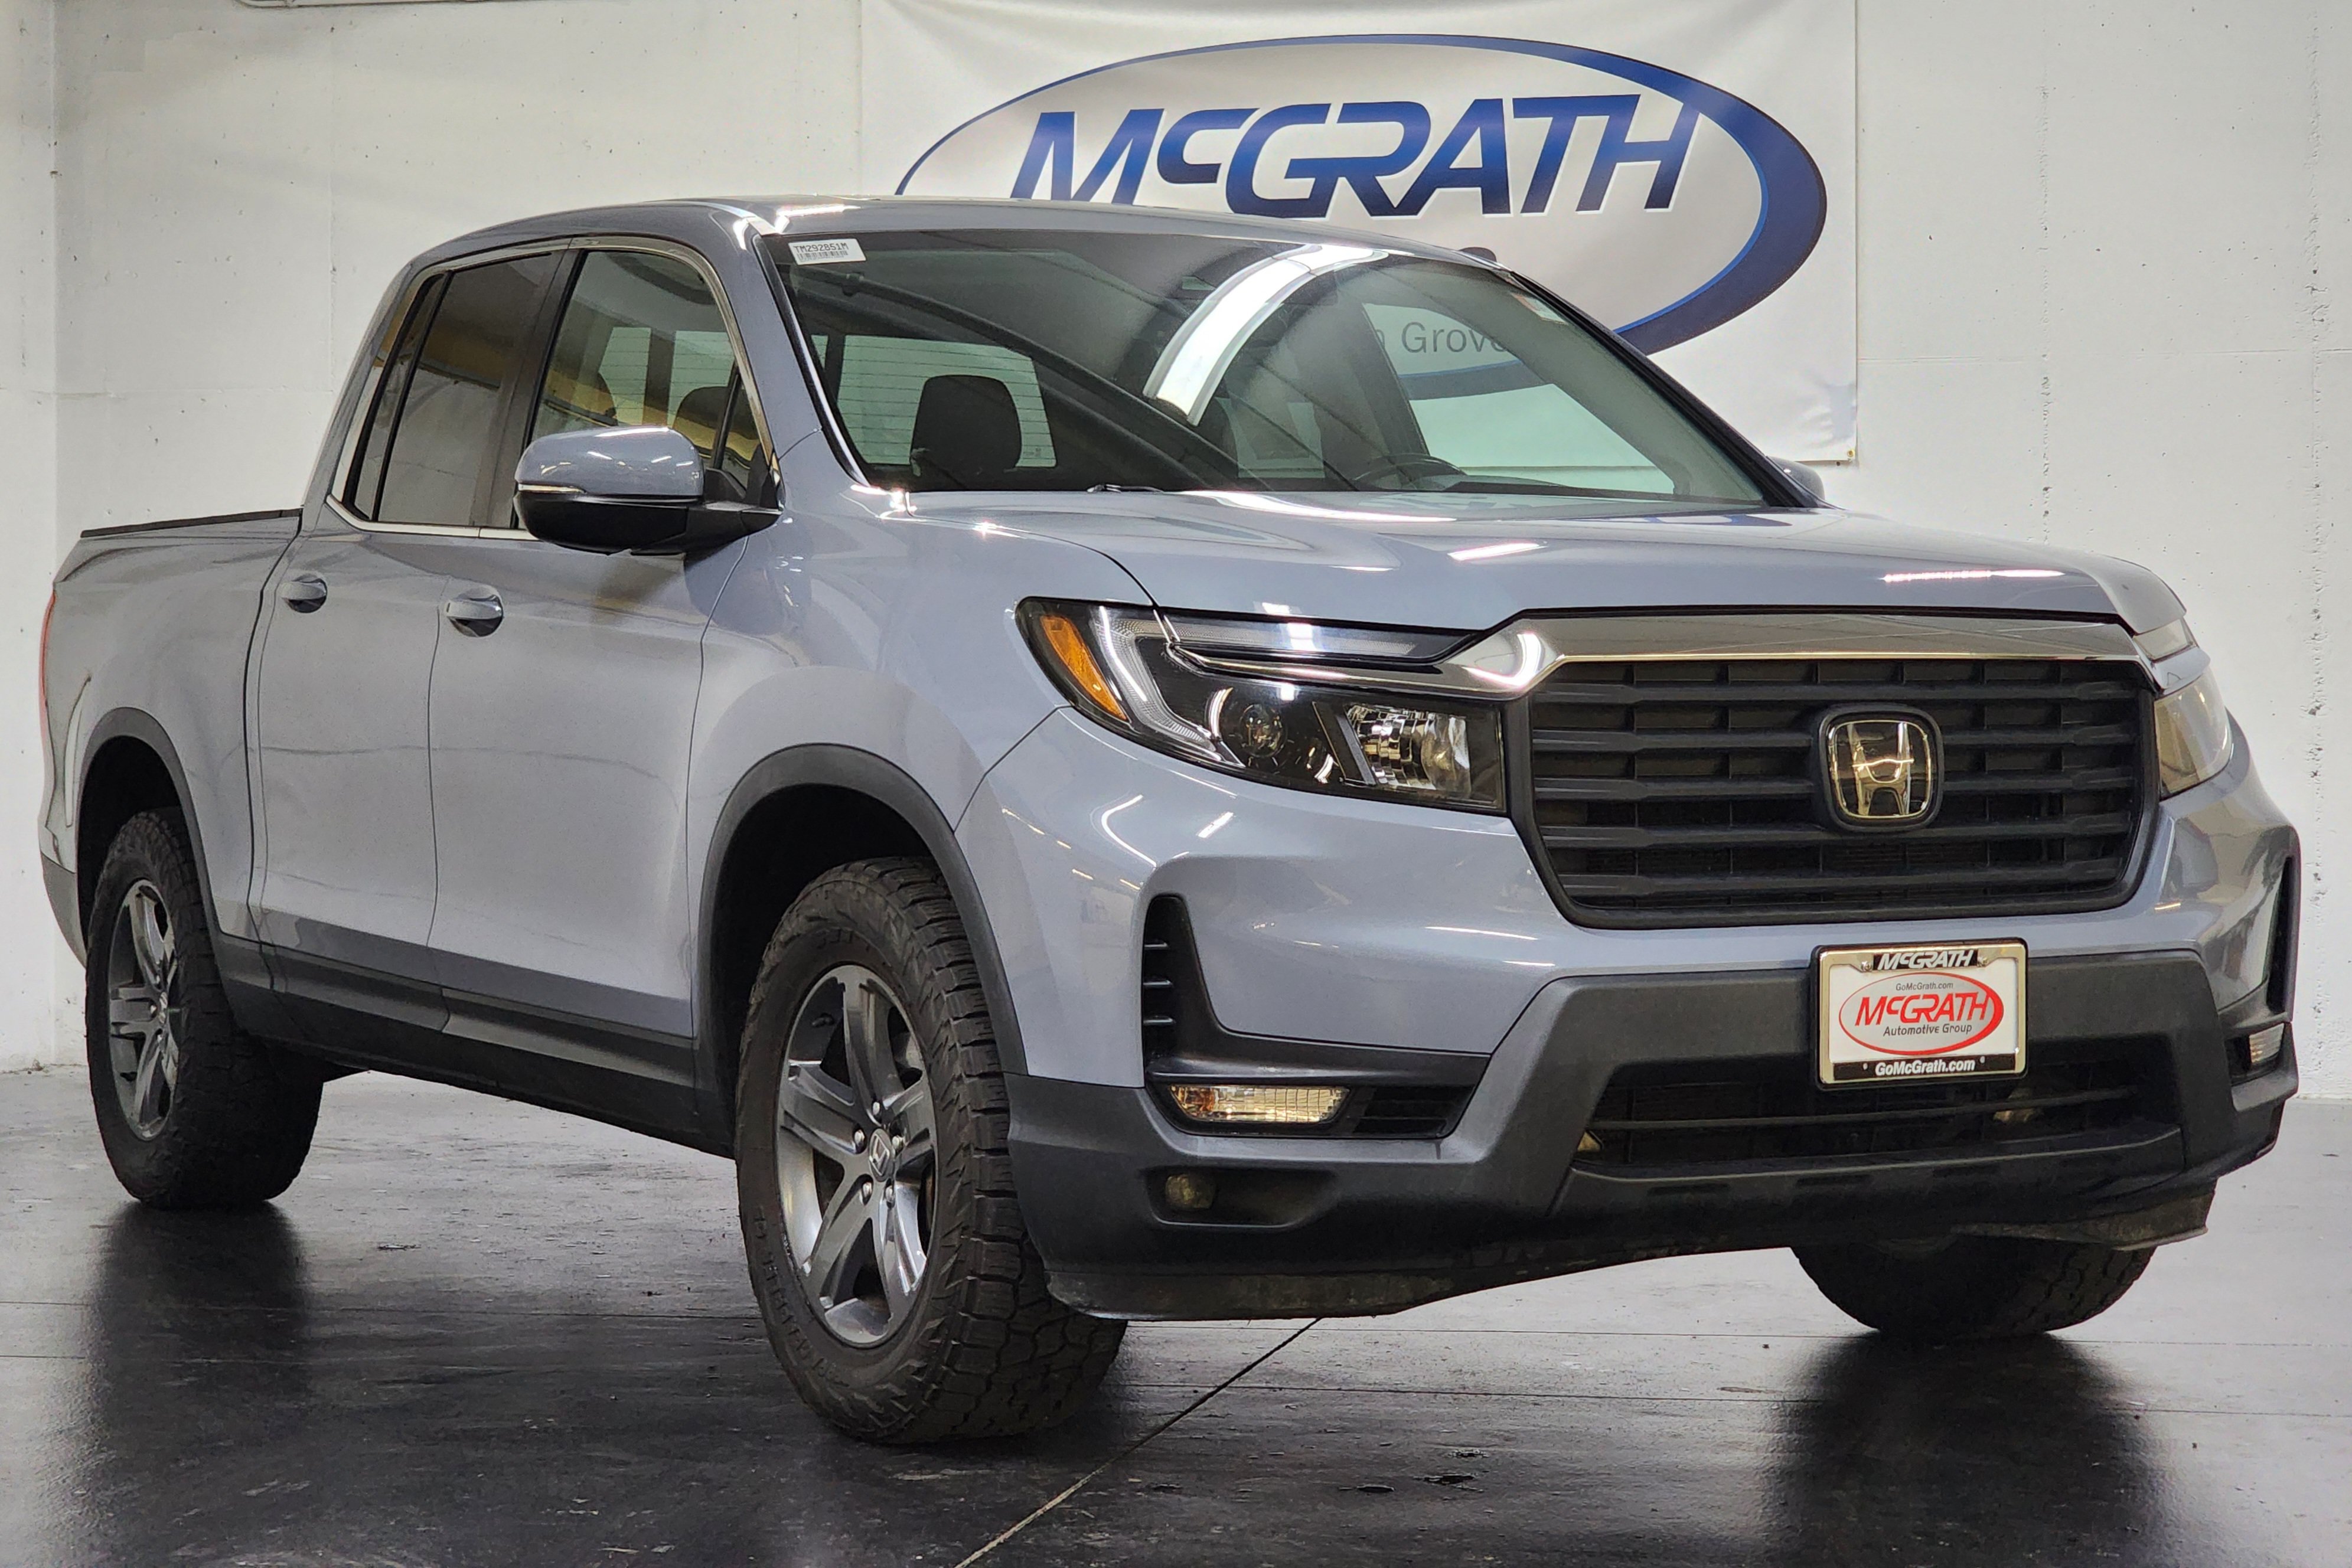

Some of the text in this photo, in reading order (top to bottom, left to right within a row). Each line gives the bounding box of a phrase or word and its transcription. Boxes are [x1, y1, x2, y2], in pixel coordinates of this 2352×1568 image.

[793, 243, 849, 253] TM292851M
[1895, 981, 1953, 991] GoMcGrath.com
[1883, 1023, 1972, 1037] Automotive Group
[1874, 1059, 1975, 1077] GoMcGrath.com
